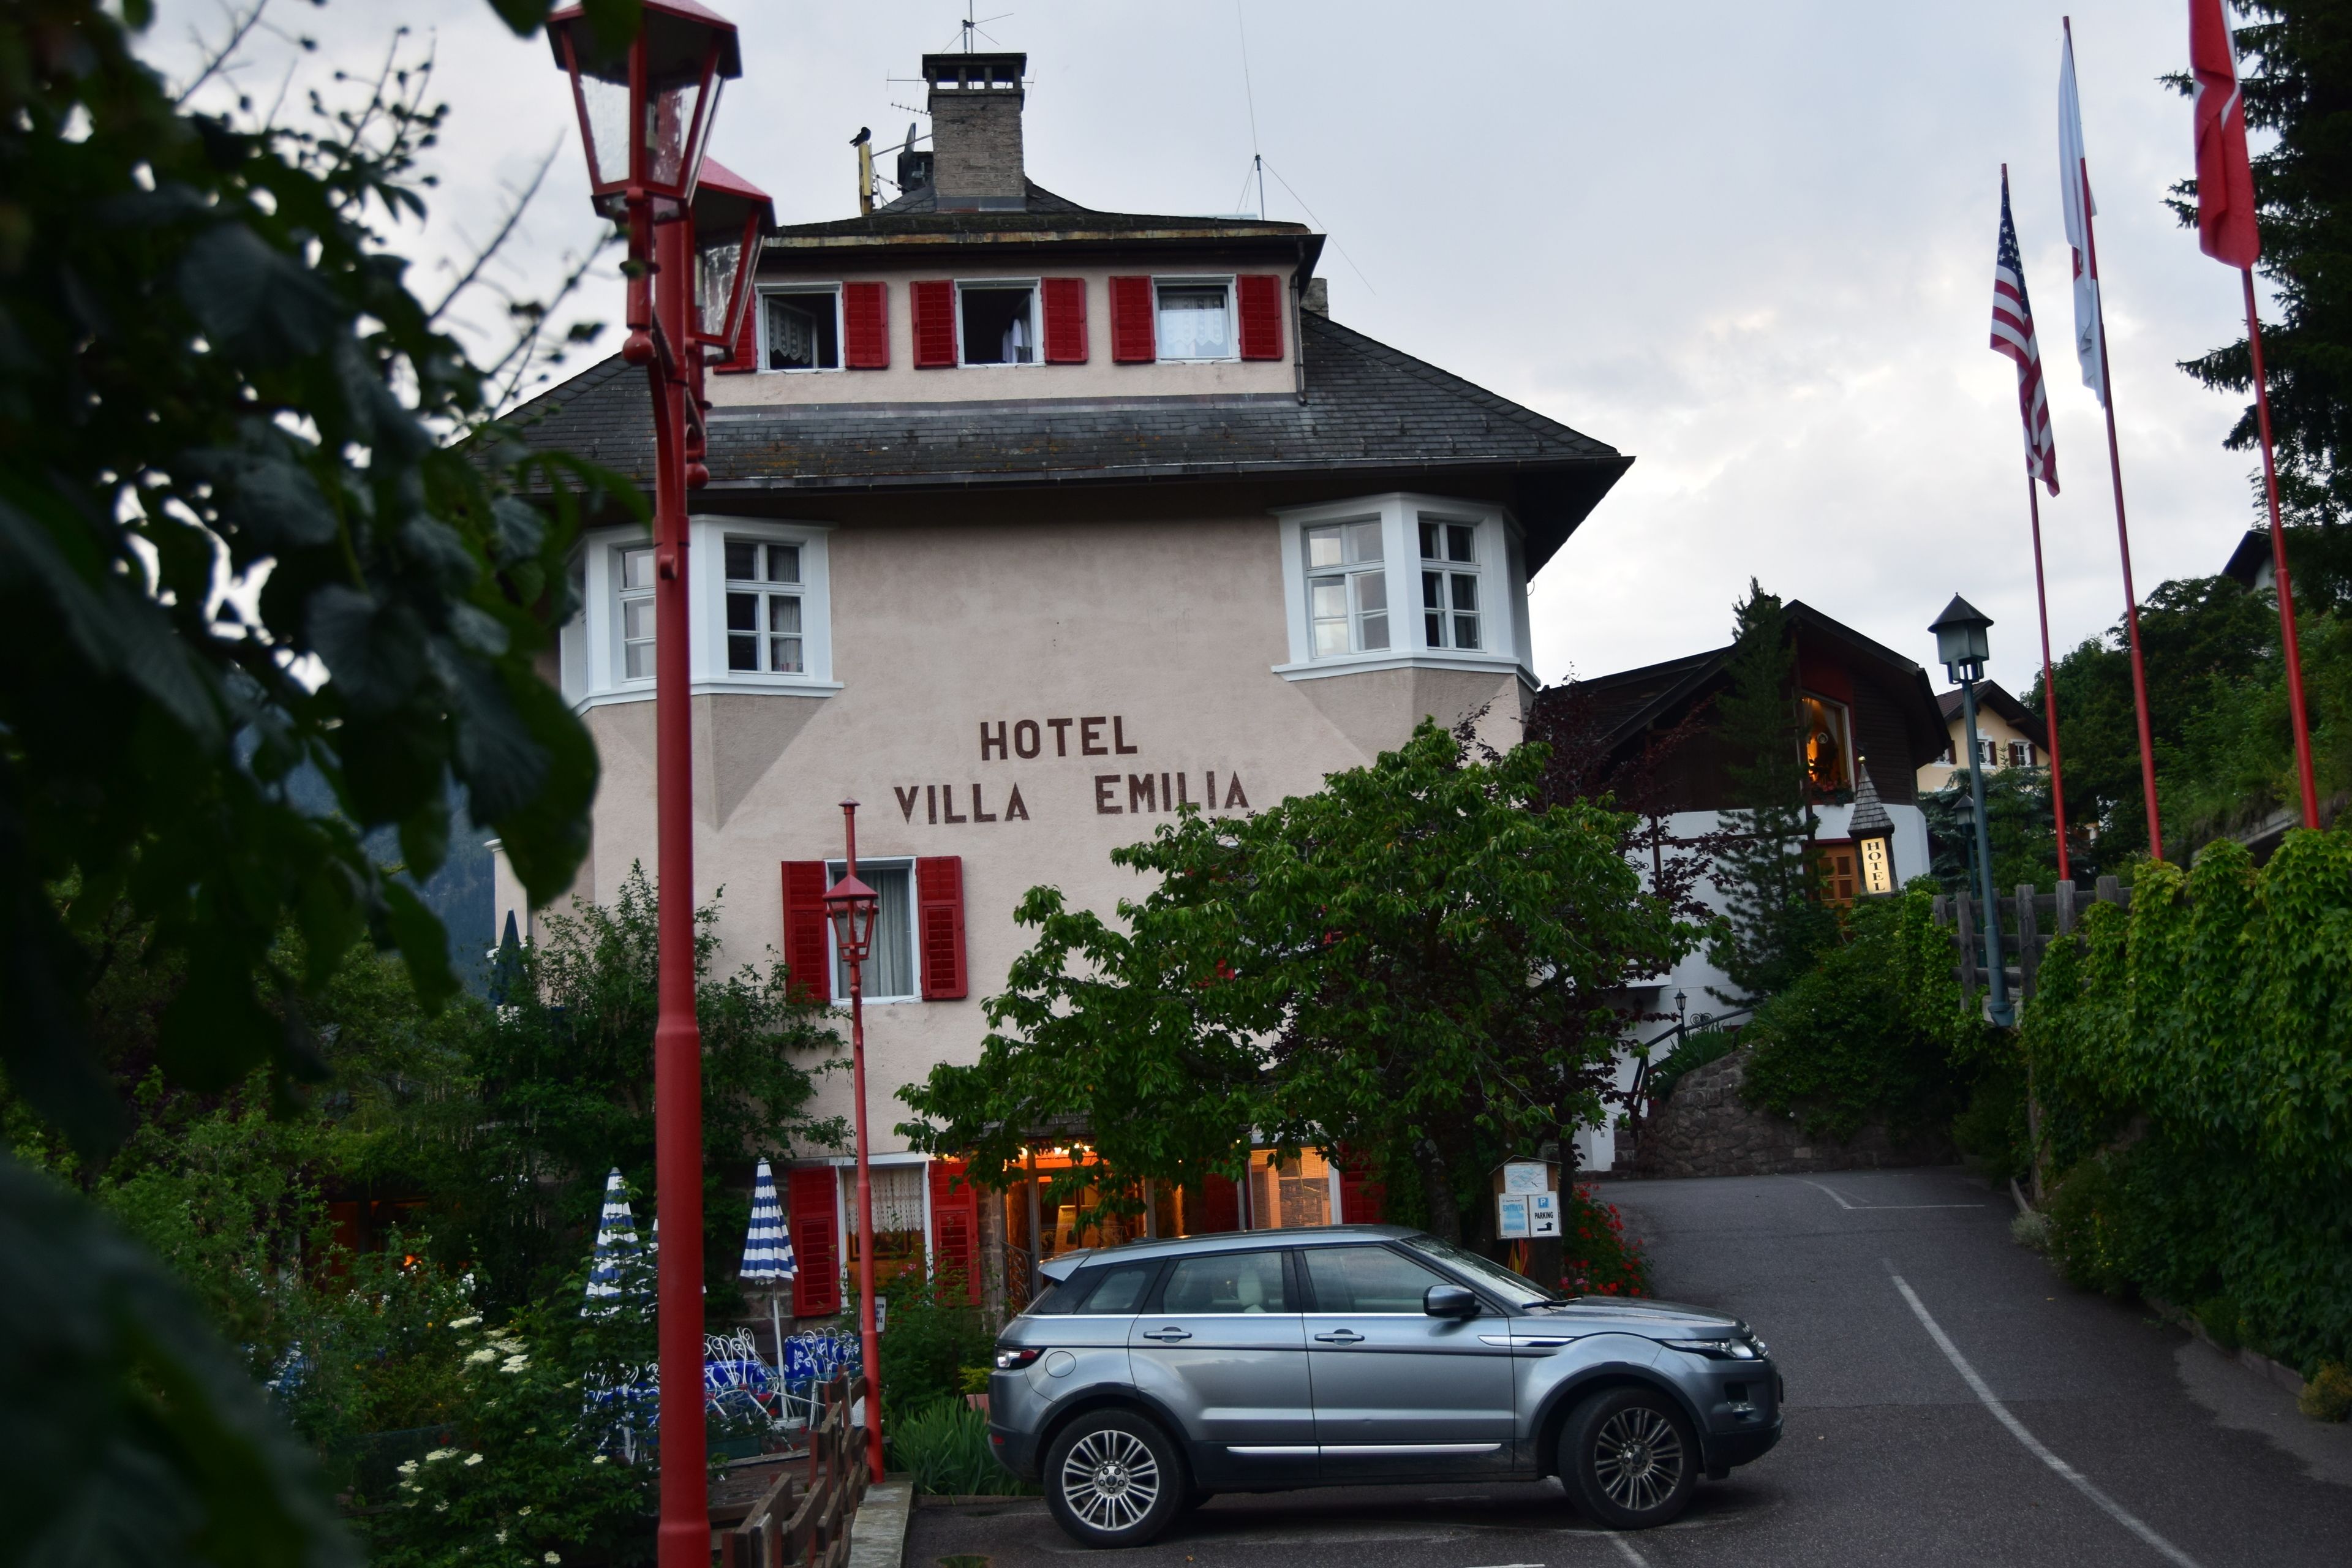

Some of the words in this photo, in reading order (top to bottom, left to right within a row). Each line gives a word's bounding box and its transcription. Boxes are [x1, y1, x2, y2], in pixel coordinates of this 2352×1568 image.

[980, 715, 1137, 761] HOTEL
[894, 782, 1030, 824] VILLA
[1095, 771, 1250, 815] EMILIA
[1867, 842, 1885, 891] HOTEL
